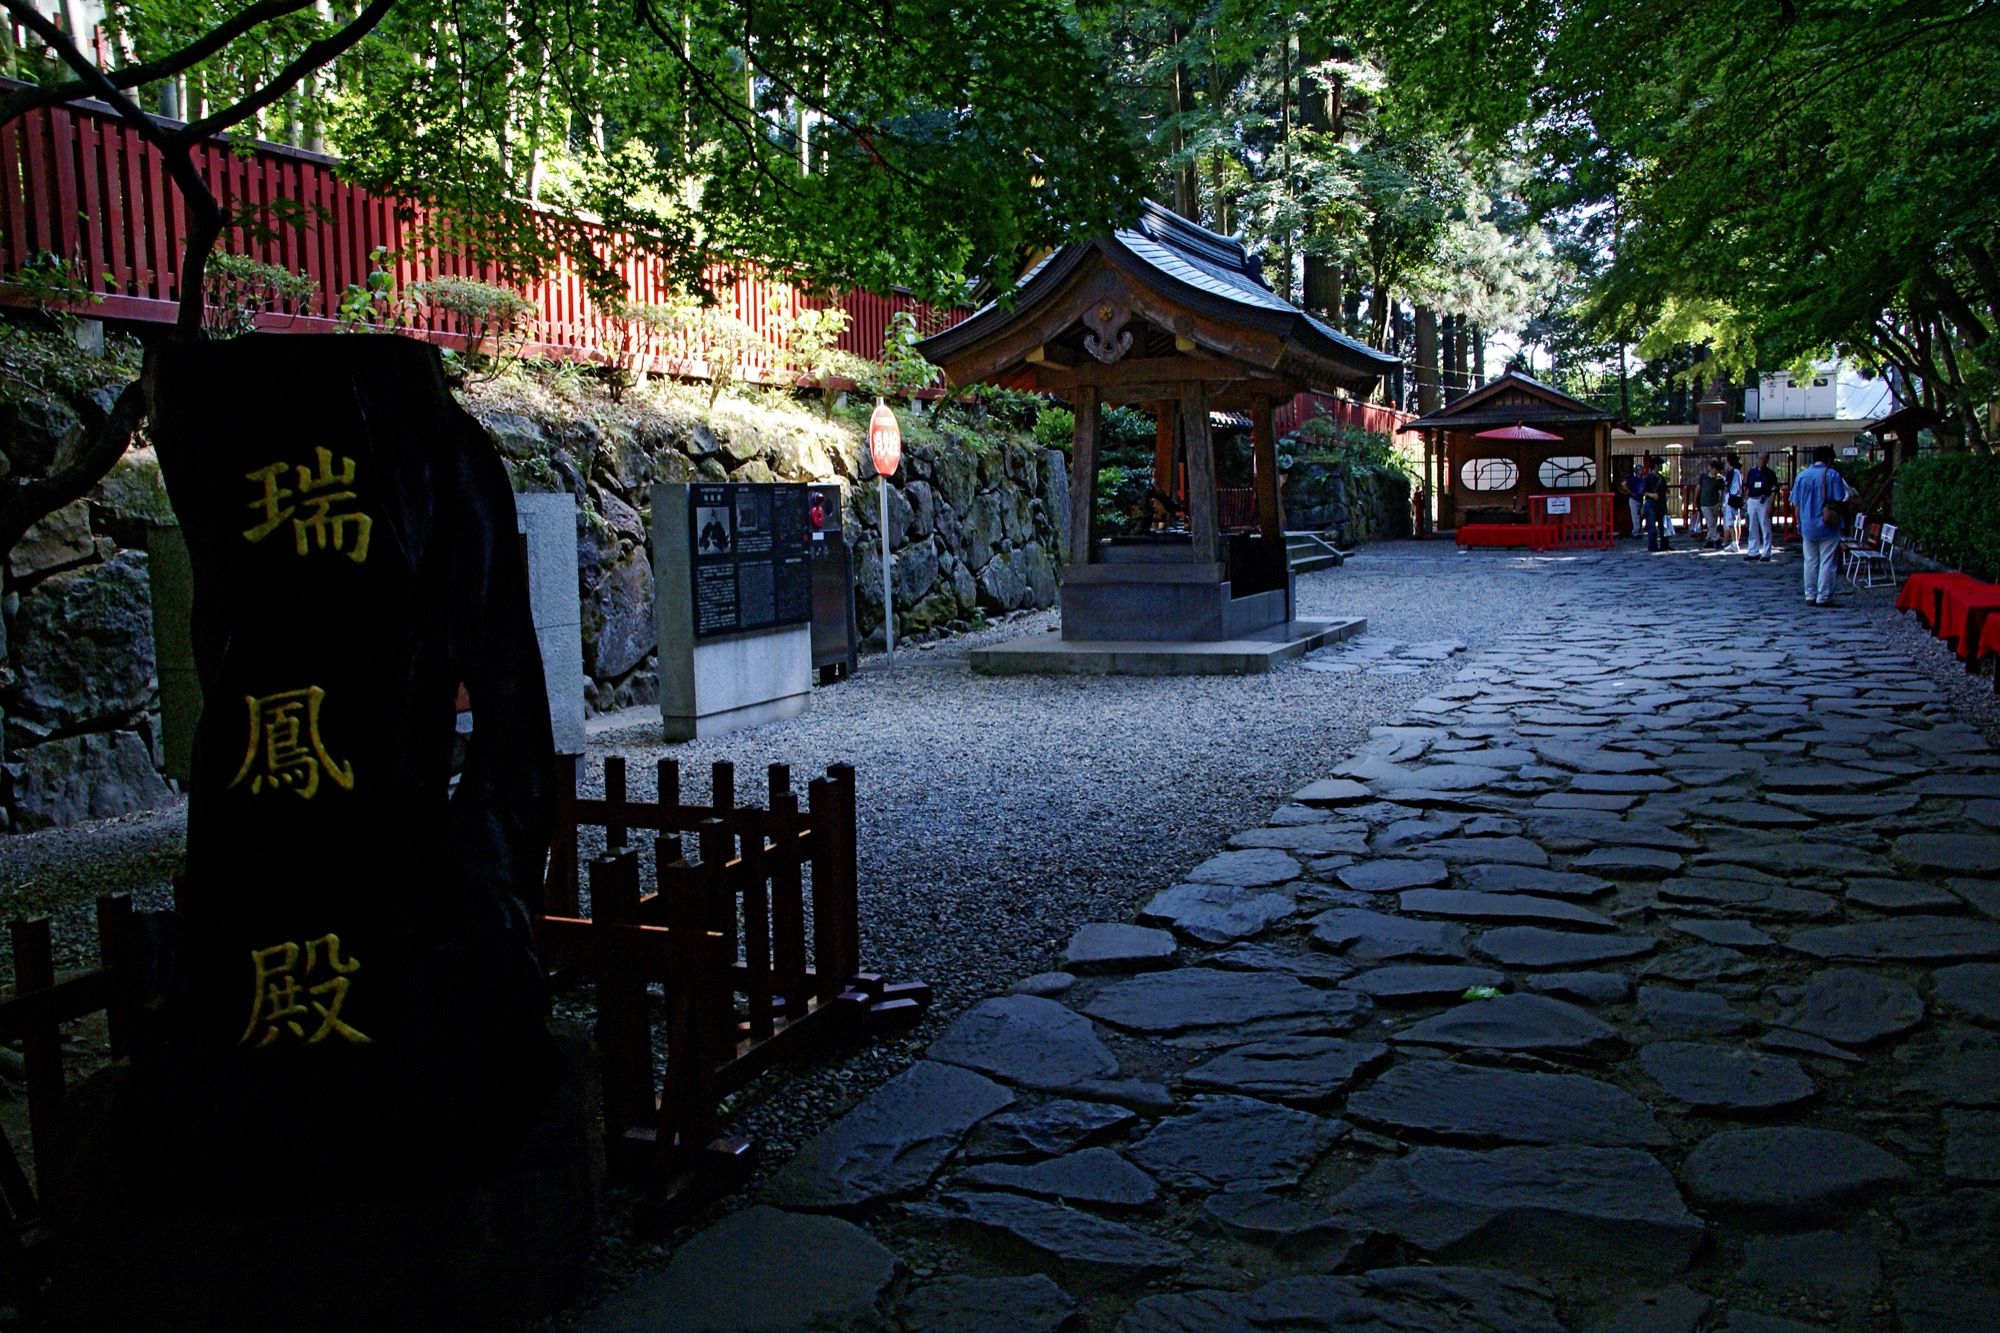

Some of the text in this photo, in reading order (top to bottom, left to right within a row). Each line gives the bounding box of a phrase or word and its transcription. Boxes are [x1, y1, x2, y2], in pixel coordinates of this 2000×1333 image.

[873, 430, 900, 457] 消火栓
[227, 445, 372, 1047] 瑞鳳殿
